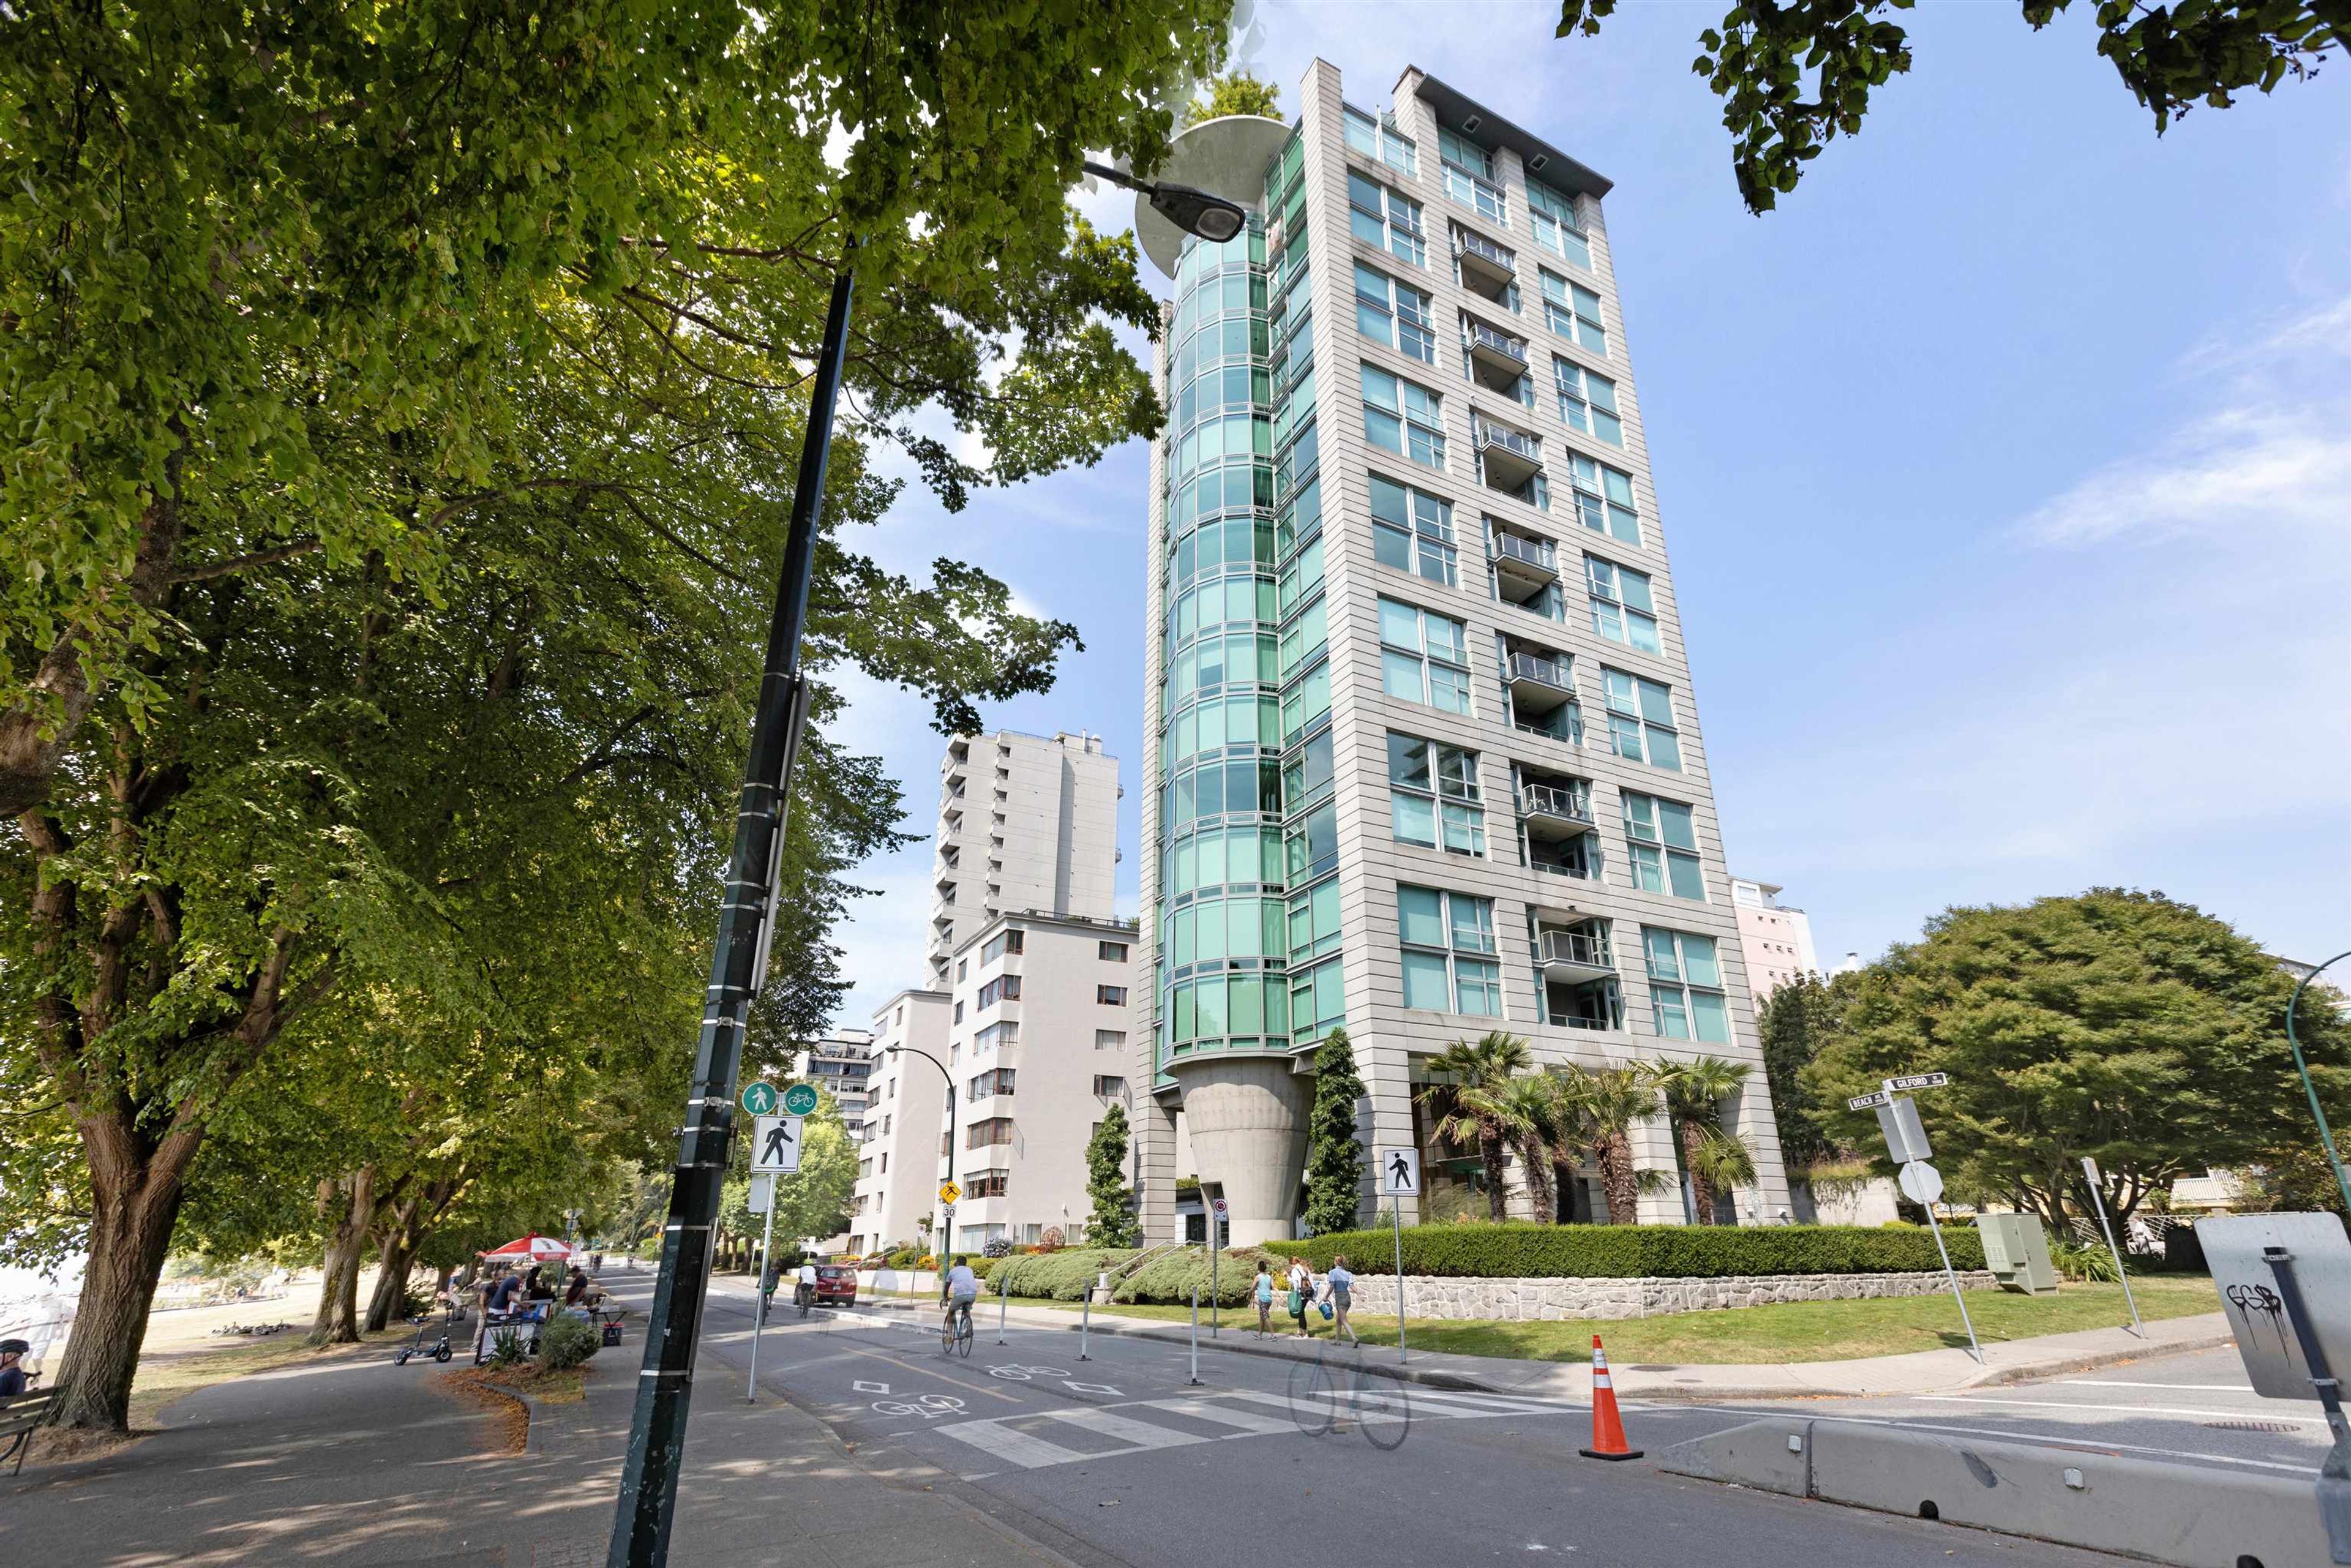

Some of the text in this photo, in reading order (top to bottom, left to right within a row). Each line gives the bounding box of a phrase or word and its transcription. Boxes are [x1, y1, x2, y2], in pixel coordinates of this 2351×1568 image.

[1897, 1078, 1927, 1088] GILFORD
[1853, 1097, 1873, 1108] BEACH
[944, 1208, 954, 1217] 30
